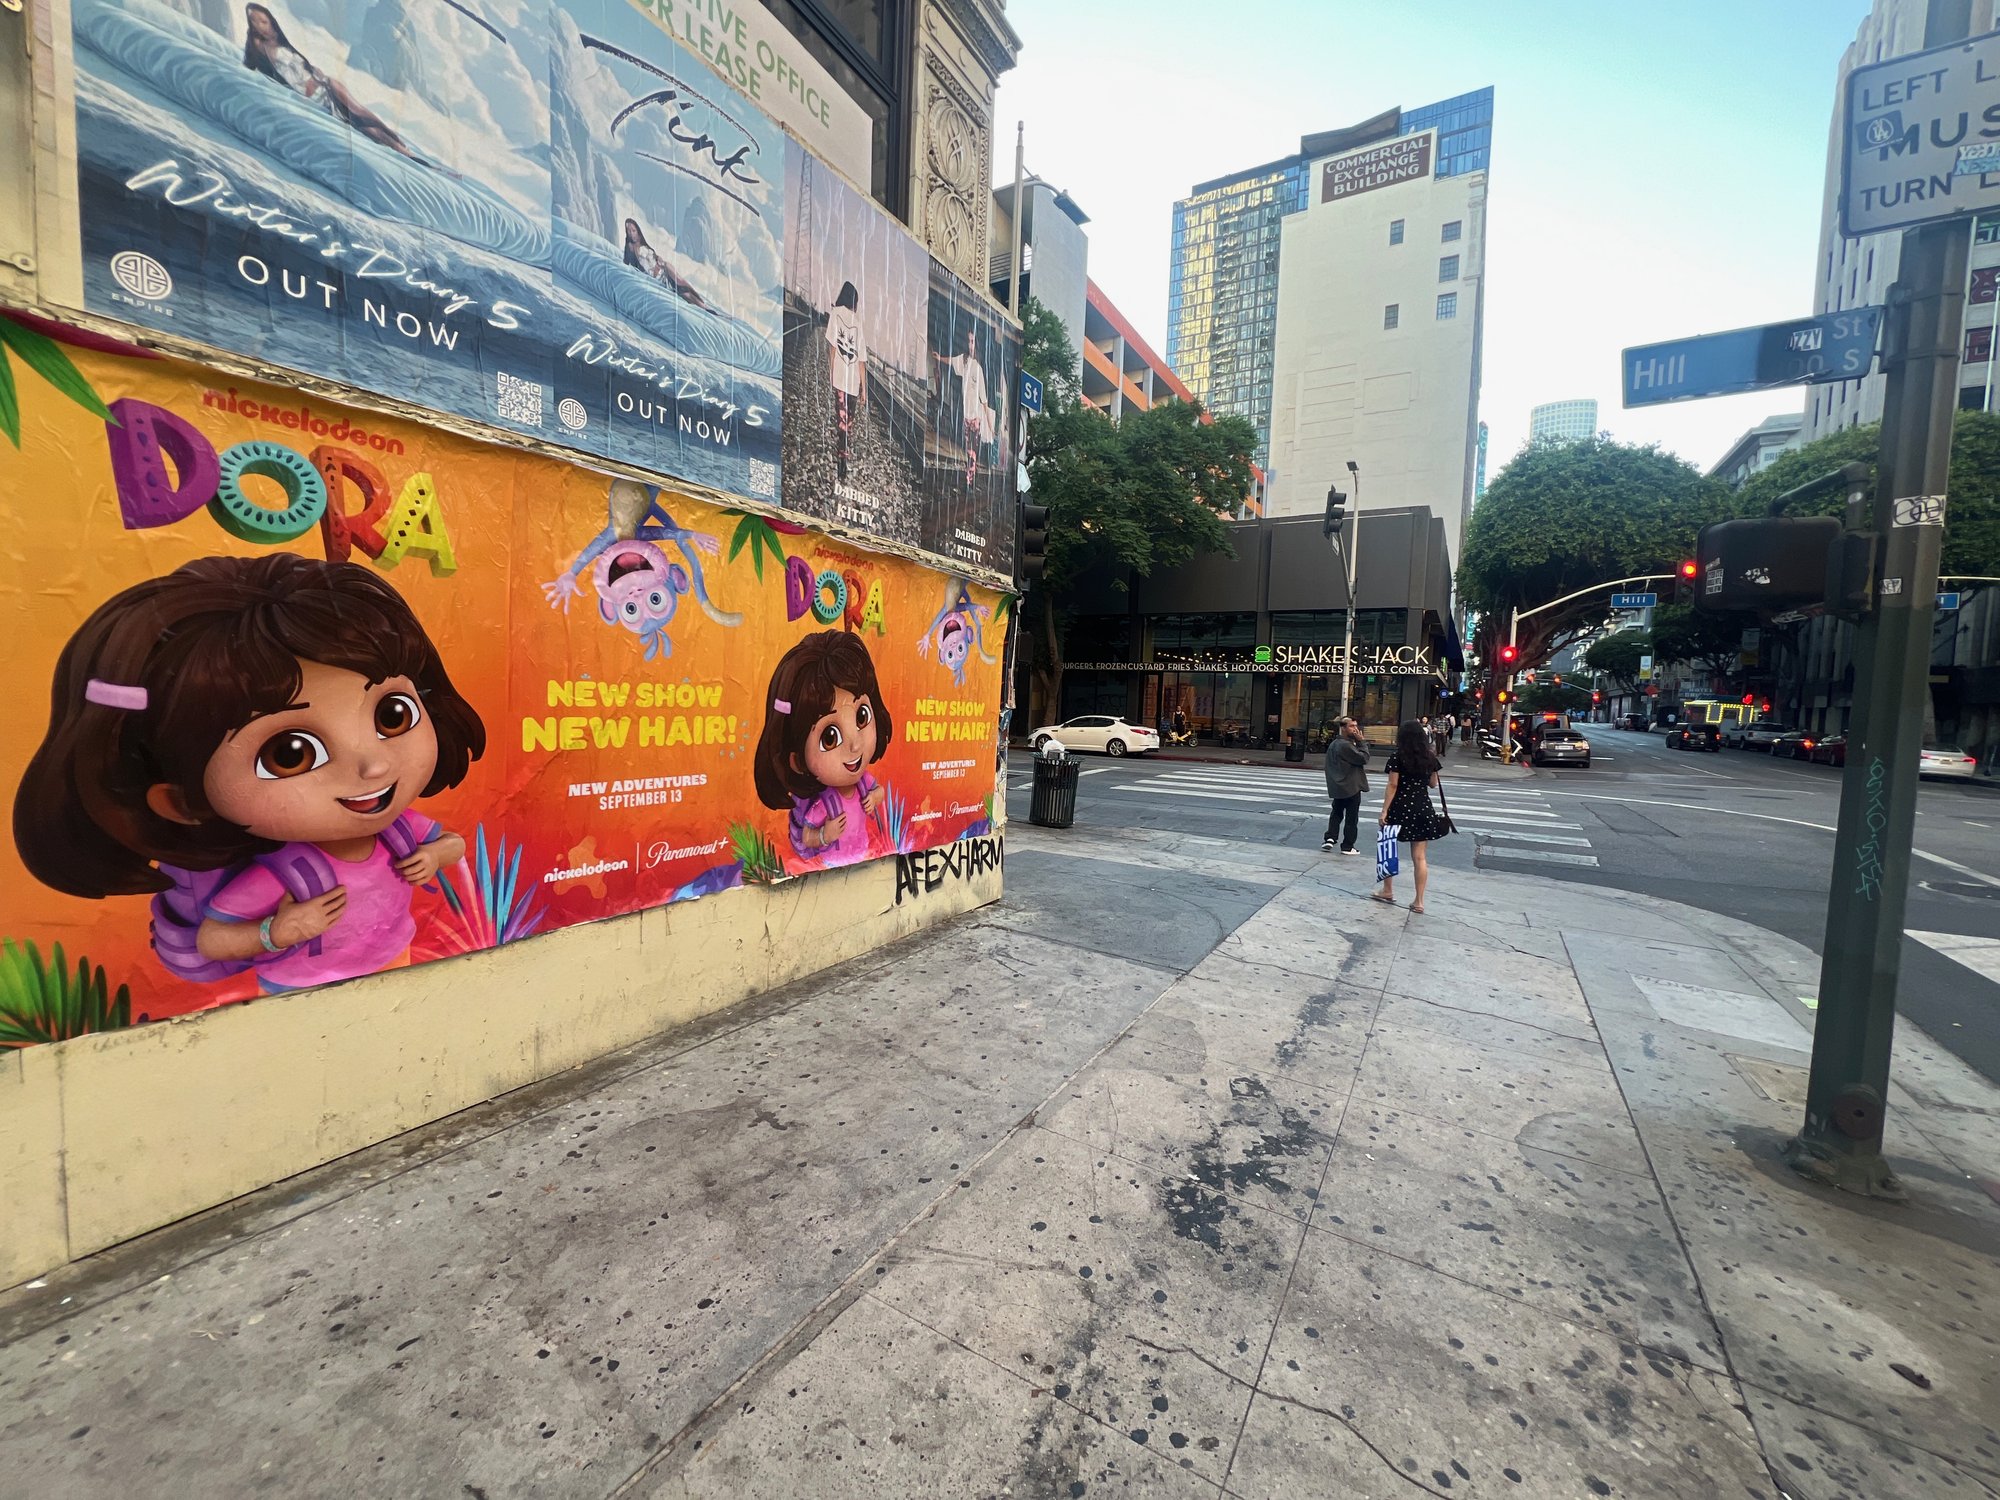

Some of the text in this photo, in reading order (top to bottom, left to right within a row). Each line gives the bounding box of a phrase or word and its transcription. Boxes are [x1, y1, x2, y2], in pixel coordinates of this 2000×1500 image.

[685, 11, 761, 101] LEASE
[756, 39, 830, 129] OFFICE
[1863, 68, 1949, 111] LEFT
[1326, 138, 1429, 174] COMMERCIAL
[1334, 151, 1419, 183] EXCHANGE
[1334, 163, 1420, 195] BUILDING
[1860, 172, 1952, 212] TURN
[351, 243, 478, 315] Diary
[111, 292, 174, 317] EMPIRE
[237, 255, 459, 351] OUT NOW
[1832, 316, 1861, 340] St
[1633, 353, 1686, 390] Hill
[675, 376, 740, 420] Diary
[1024, 382, 1039, 403] St
[203, 388, 405, 456] nickelodeon
[617, 392, 731, 446] OUT NOW
[105, 397, 458, 578] DORA
[834, 483, 881, 509] DABBED
[836, 503, 875, 527] KITTY
[955, 528, 986, 548] DABBED
[813, 544, 874, 571] nickelodeon
[957, 545, 983, 563] KITTY
[785, 555, 886, 637] DORA
[1096, 662, 1127, 671] FROZEN
[1128, 663, 1164, 671] CUSTARD
[1194, 664, 1228, 672] SHAKES
[1232, 664, 1251, 672] HOT
[1252, 665, 1279, 673] DOGS
[1283, 665, 1343, 674] CONCRETES
[1390, 665, 1429, 675] CONES
[1275, 646, 1345, 664] SHAKE
[547, 680, 723, 708] NEW SHOW
[916, 699, 985, 717] NEW SHOW
[522, 715, 738, 752] NEW HAIR!
[906, 720, 991, 742] NEW HAIR!
[922, 760, 976, 770] NEW ADVENTURES
[933, 770, 960, 780] SEPTEMBER
[568, 774, 707, 797] NEW ADVENTURES
[599, 789, 682, 811] SEPTEMBER 13
[544, 837, 729, 883] nickelodeon Paramount+
